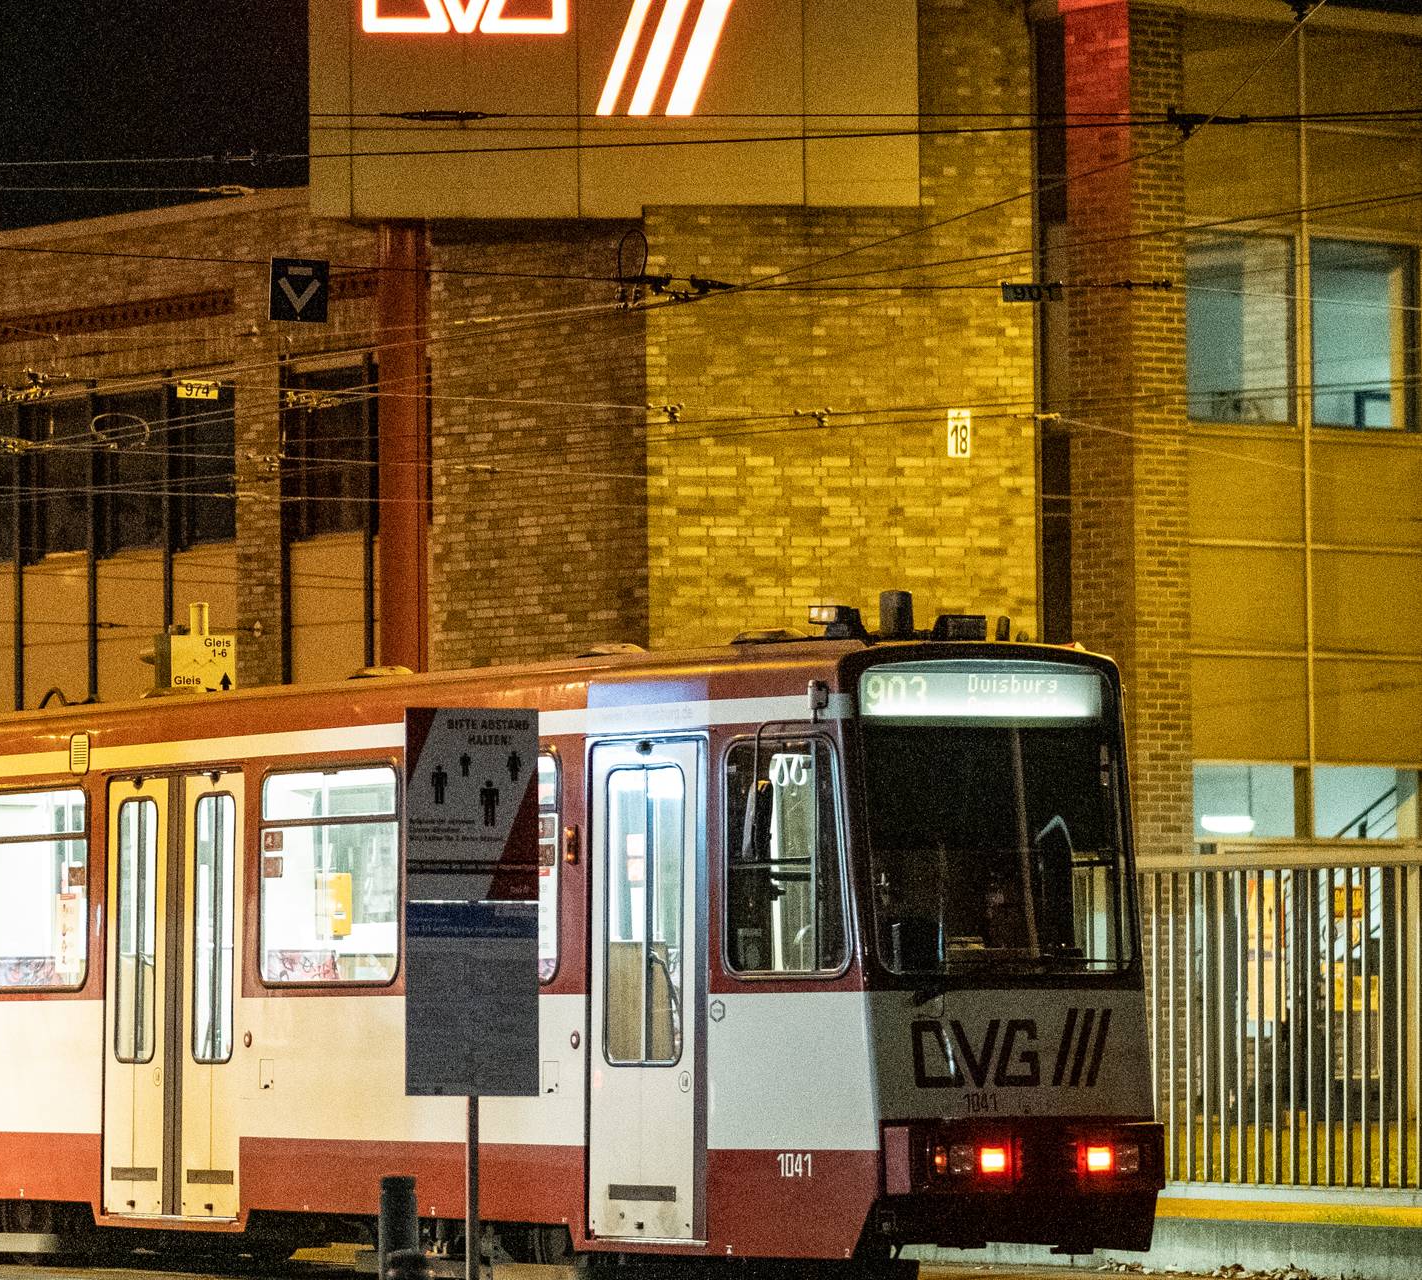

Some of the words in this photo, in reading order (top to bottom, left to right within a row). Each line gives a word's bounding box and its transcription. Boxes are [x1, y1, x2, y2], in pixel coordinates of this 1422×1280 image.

[185, 382, 210, 397] 974
[950, 425, 968, 454] 18
[204, 638, 231, 647] Gleis
[212, 649, 227, 657] 1-6
[174, 675, 201, 685] Gleis
[967, 674, 1058, 694] Duisburg
[866, 675, 927, 714] 903
[447, 719, 477, 730] BITTE
[481, 719, 529, 731] ABSTAND
[910, 1018, 1041, 1089] DVG
[964, 1093, 998, 1113] 1041
[777, 1153, 812, 1177] 1041
